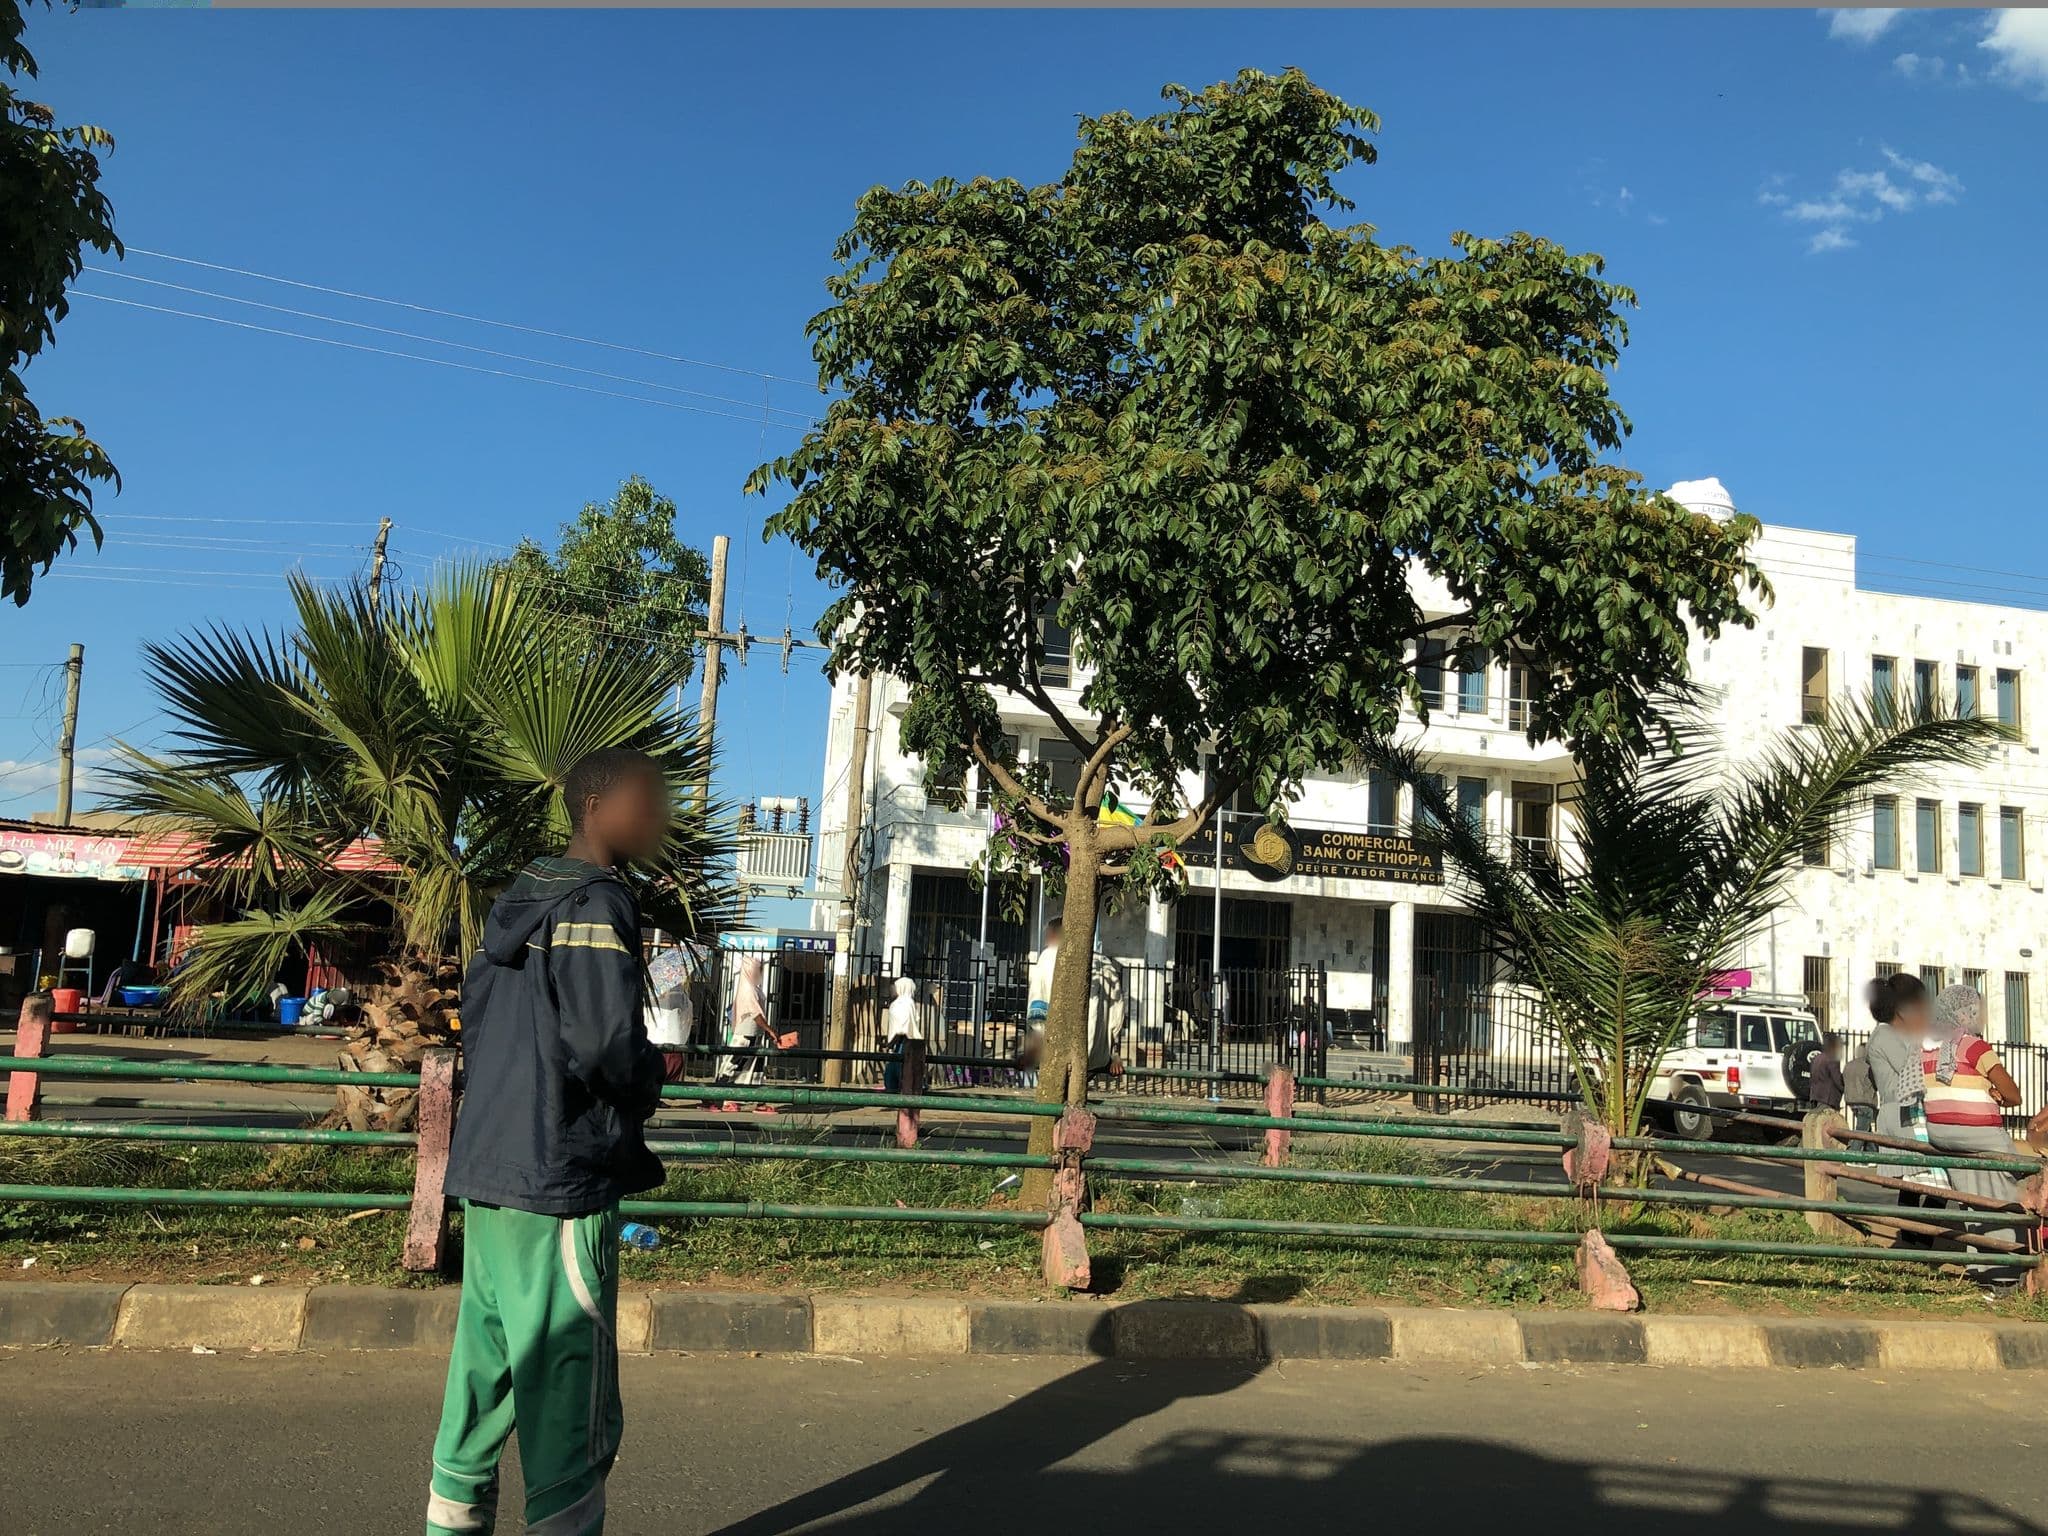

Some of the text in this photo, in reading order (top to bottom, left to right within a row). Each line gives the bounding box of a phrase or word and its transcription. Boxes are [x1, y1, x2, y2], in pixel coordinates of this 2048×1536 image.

[1321, 833, 1415, 852] COMMERCIAL
[1303, 845, 1432, 867] BANK OF ETHIOPIA
[1296, 863, 1445, 883] DEBRE TABOR BRANCH
[727, 936, 769, 948] ATM
